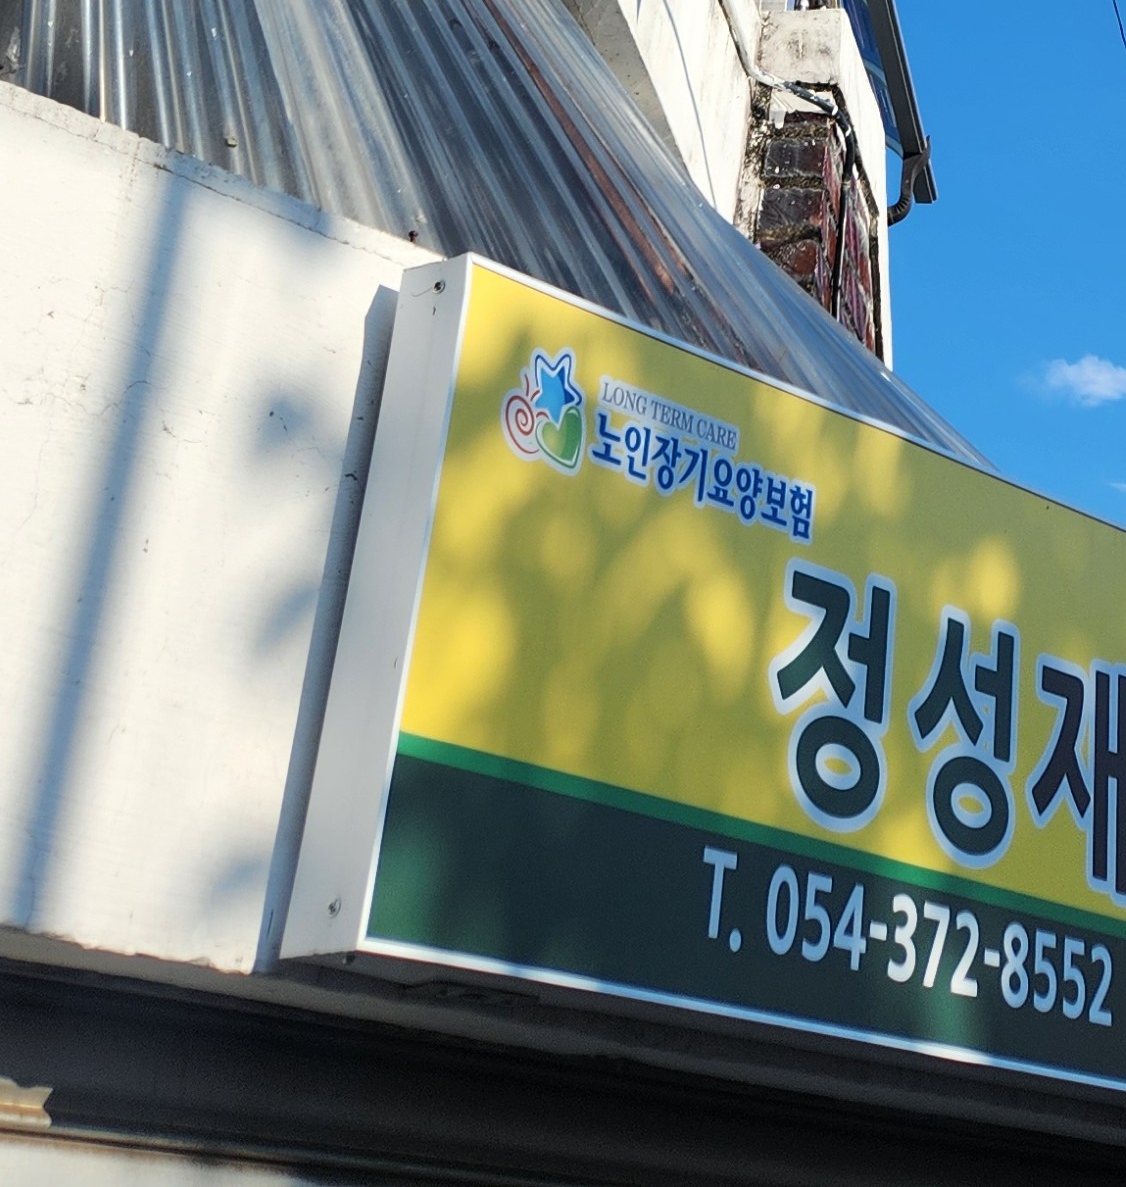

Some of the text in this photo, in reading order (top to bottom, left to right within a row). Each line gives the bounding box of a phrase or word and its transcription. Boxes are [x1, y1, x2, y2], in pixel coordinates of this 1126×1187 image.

[592, 413, 812, 540] 노인장기요양보험
[602, 382, 737, 450] LONG TERM CARE
[703, 845, 1112, 1027] T. 054-372-8552
